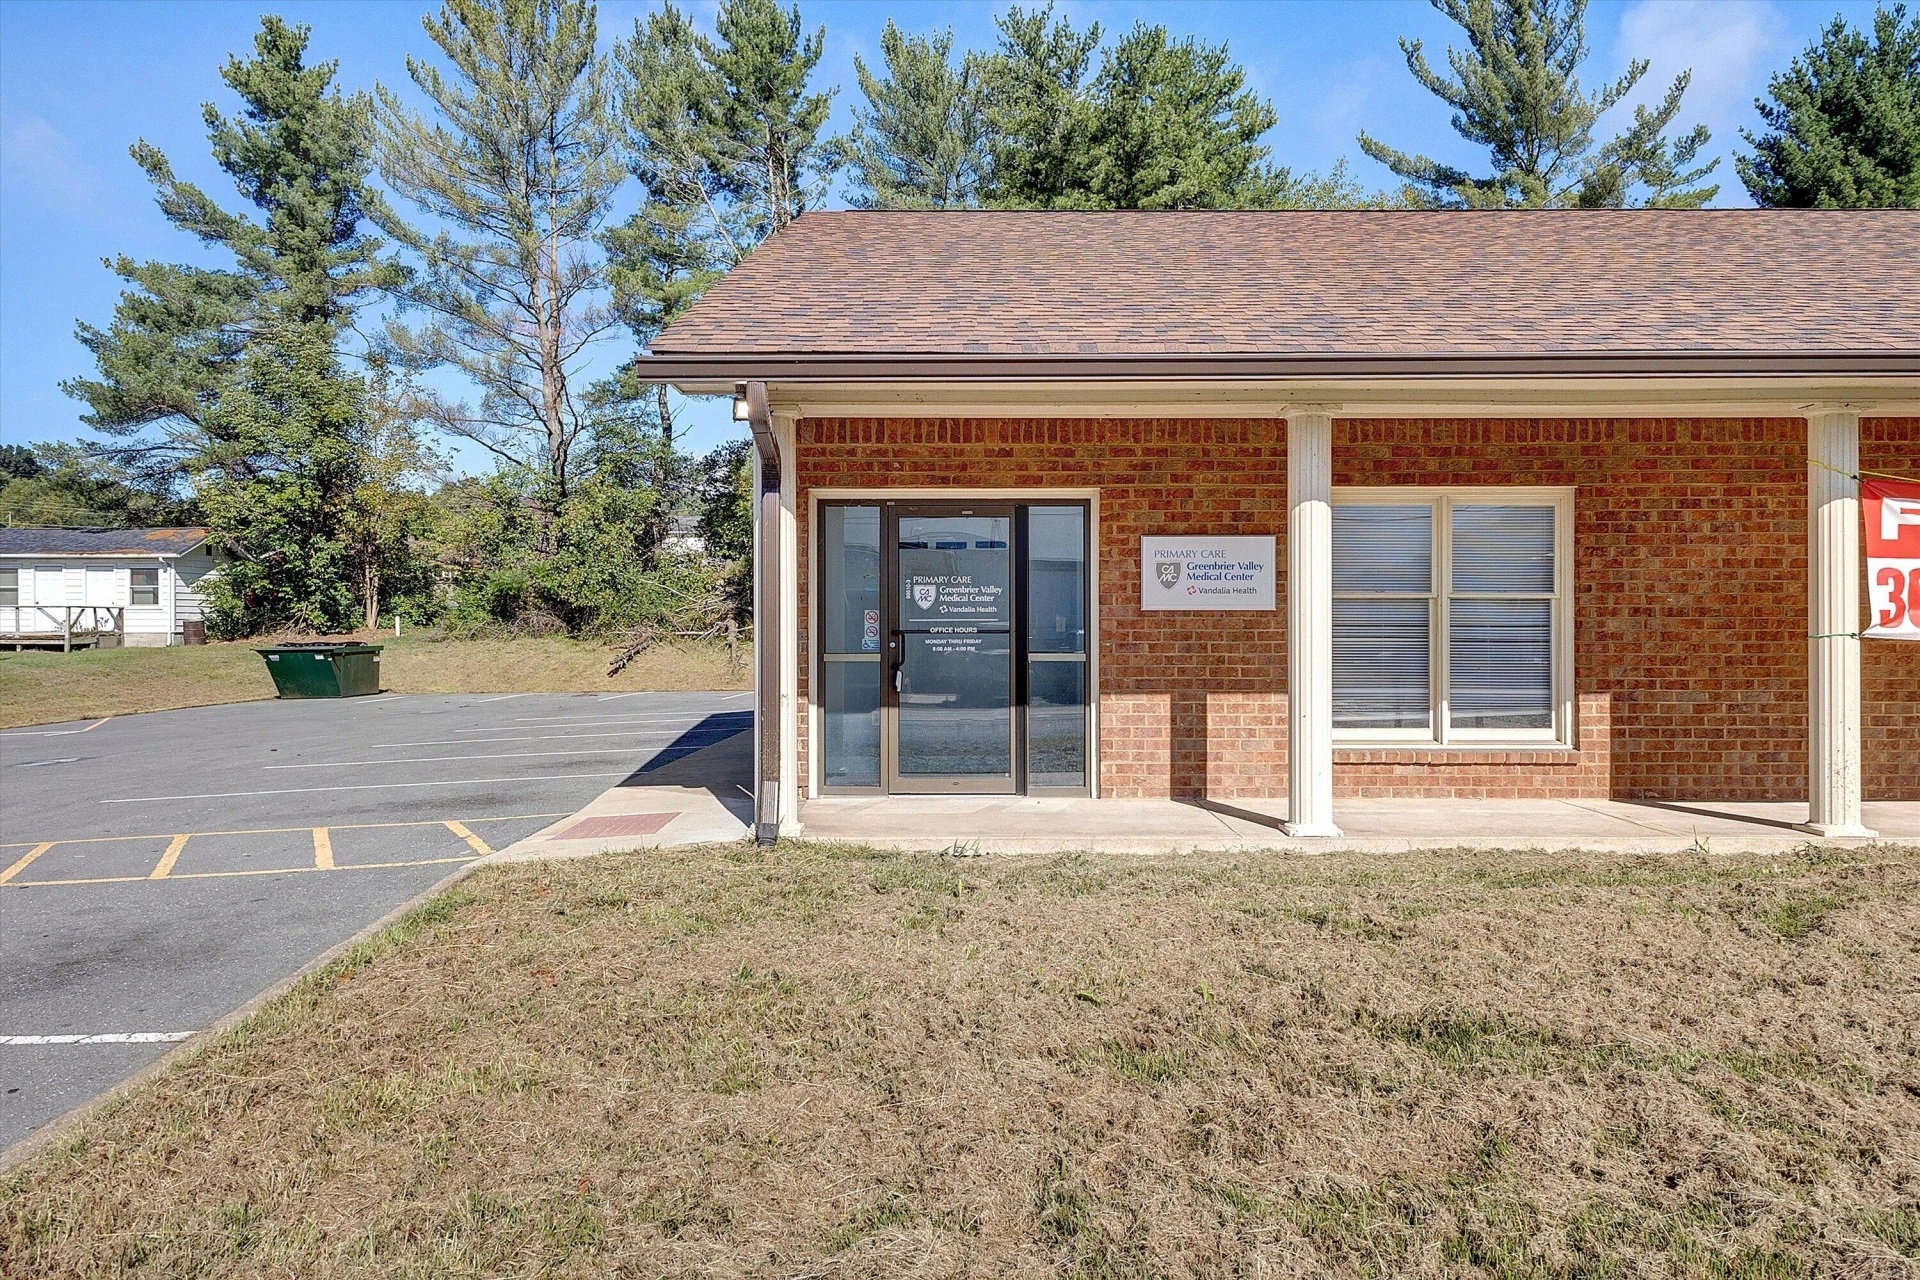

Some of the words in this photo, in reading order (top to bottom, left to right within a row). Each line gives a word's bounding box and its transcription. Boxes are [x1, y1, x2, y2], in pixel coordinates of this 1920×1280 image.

[1154, 550, 1198, 558] PRIMARY
[1200, 550, 1226, 558] CARE
[1186, 561, 1235, 570] Greenbrier
[1237, 561, 1264, 572] Valley
[1186, 572, 1221, 581] Medical
[1224, 572, 1254, 581] Center
[940, 586, 979, 594] Greenbrier
[980, 586, 1002, 595] Valley
